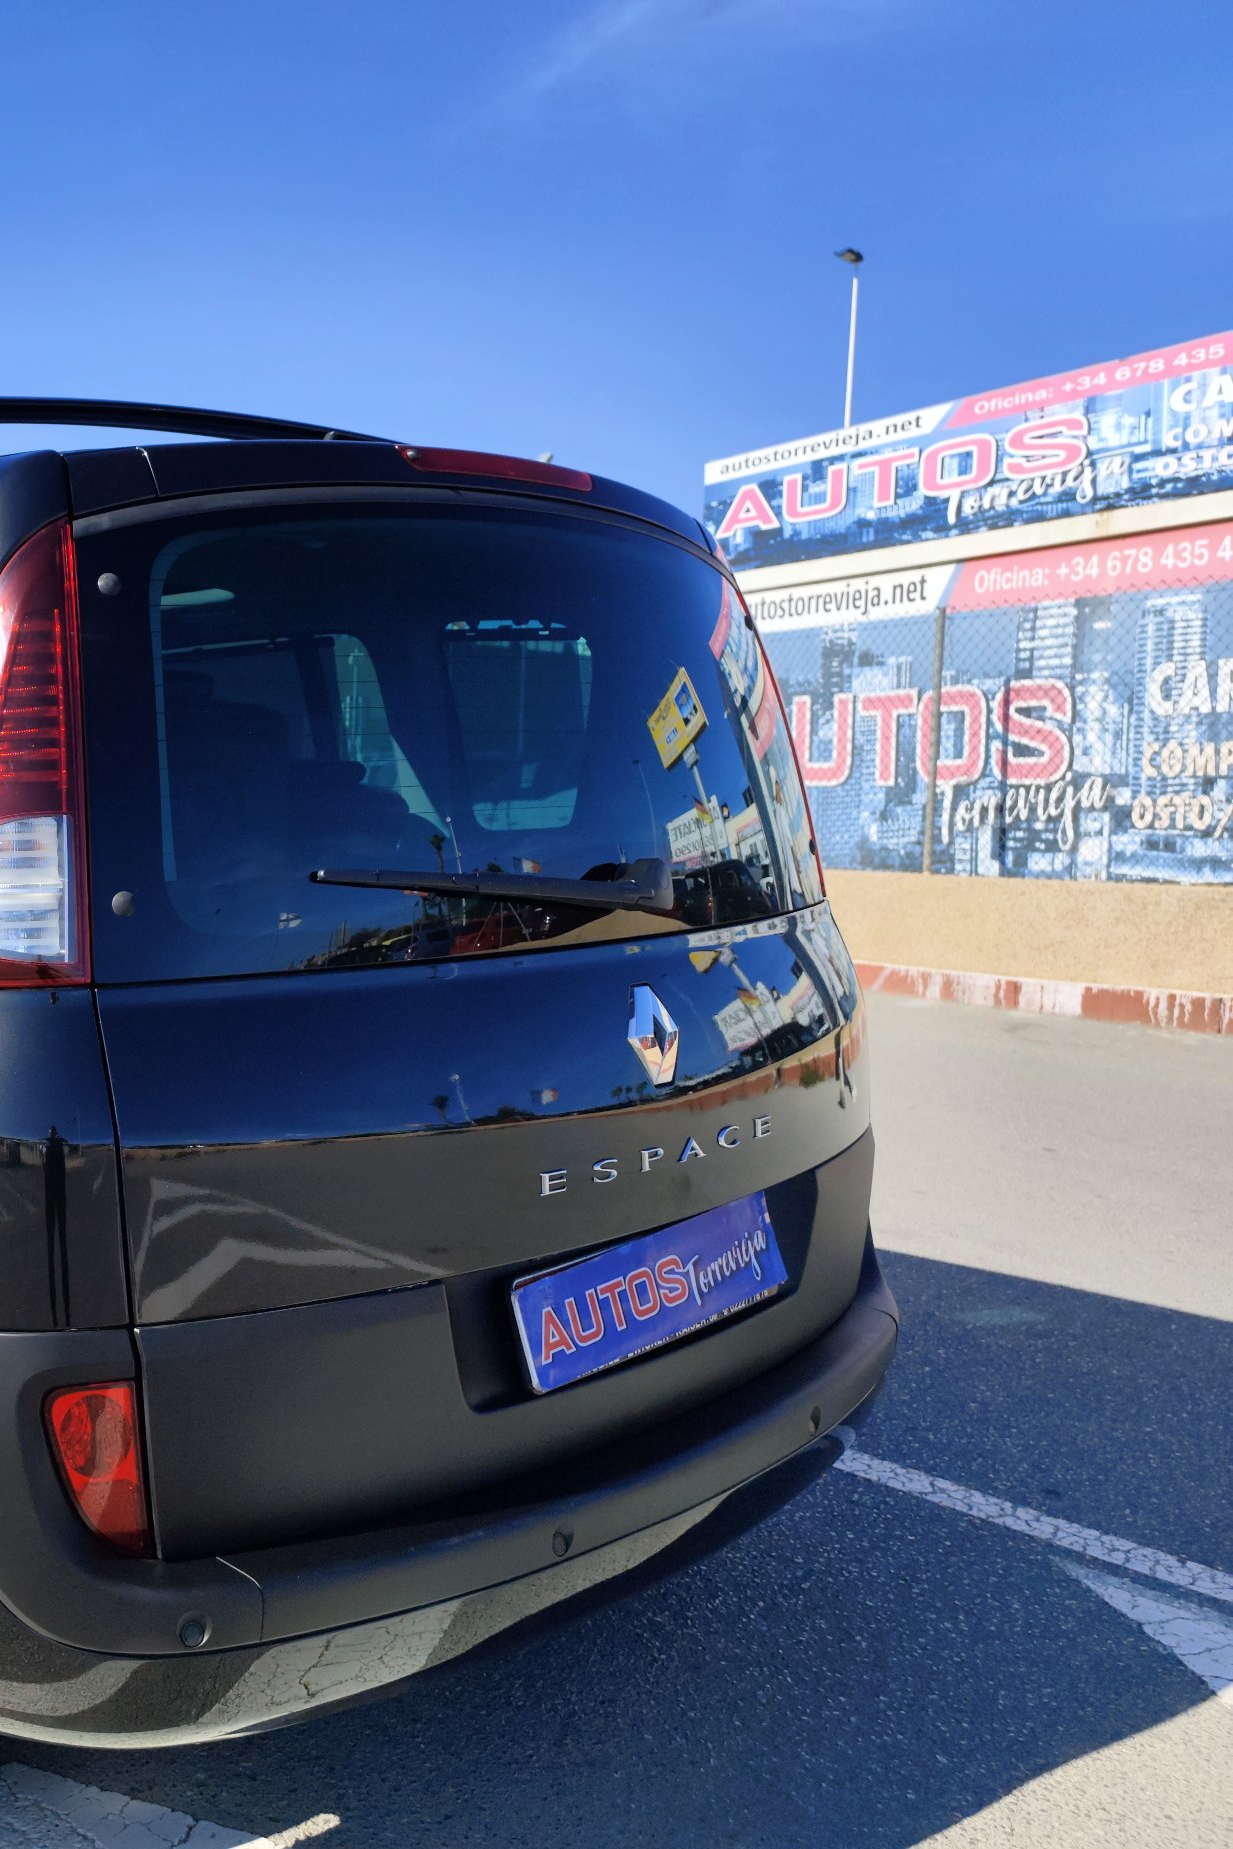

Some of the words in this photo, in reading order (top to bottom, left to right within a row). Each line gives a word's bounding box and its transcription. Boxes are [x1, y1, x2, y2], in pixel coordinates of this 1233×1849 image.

[974, 386, 1054, 416] Oficina:
[1061, 373, 1107, 393] +34
[1114, 357, 1165, 382] 678
[1172, 343, 1225, 368] 435
[716, 412, 1090, 540] AUTOS
[719, 414, 923, 475] autostorrevieja.net
[946, 453, 1131, 526] Torrevieja
[749, 574, 927, 622] utostorrevieja.net
[974, 568, 1050, 594] Oficina:
[1056, 554, 1100, 582] +34
[1106, 547, 1153, 576] 678
[1159, 539, 1209, 570] 435
[791, 678, 1073, 787] UTOS
[936, 772, 1111, 850] Torrevieja
[540, 1115, 772, 1196] ESPACE
[541, 1254, 688, 1366] AUTOS
[684, 1227, 766, 1306] Torrevieja
